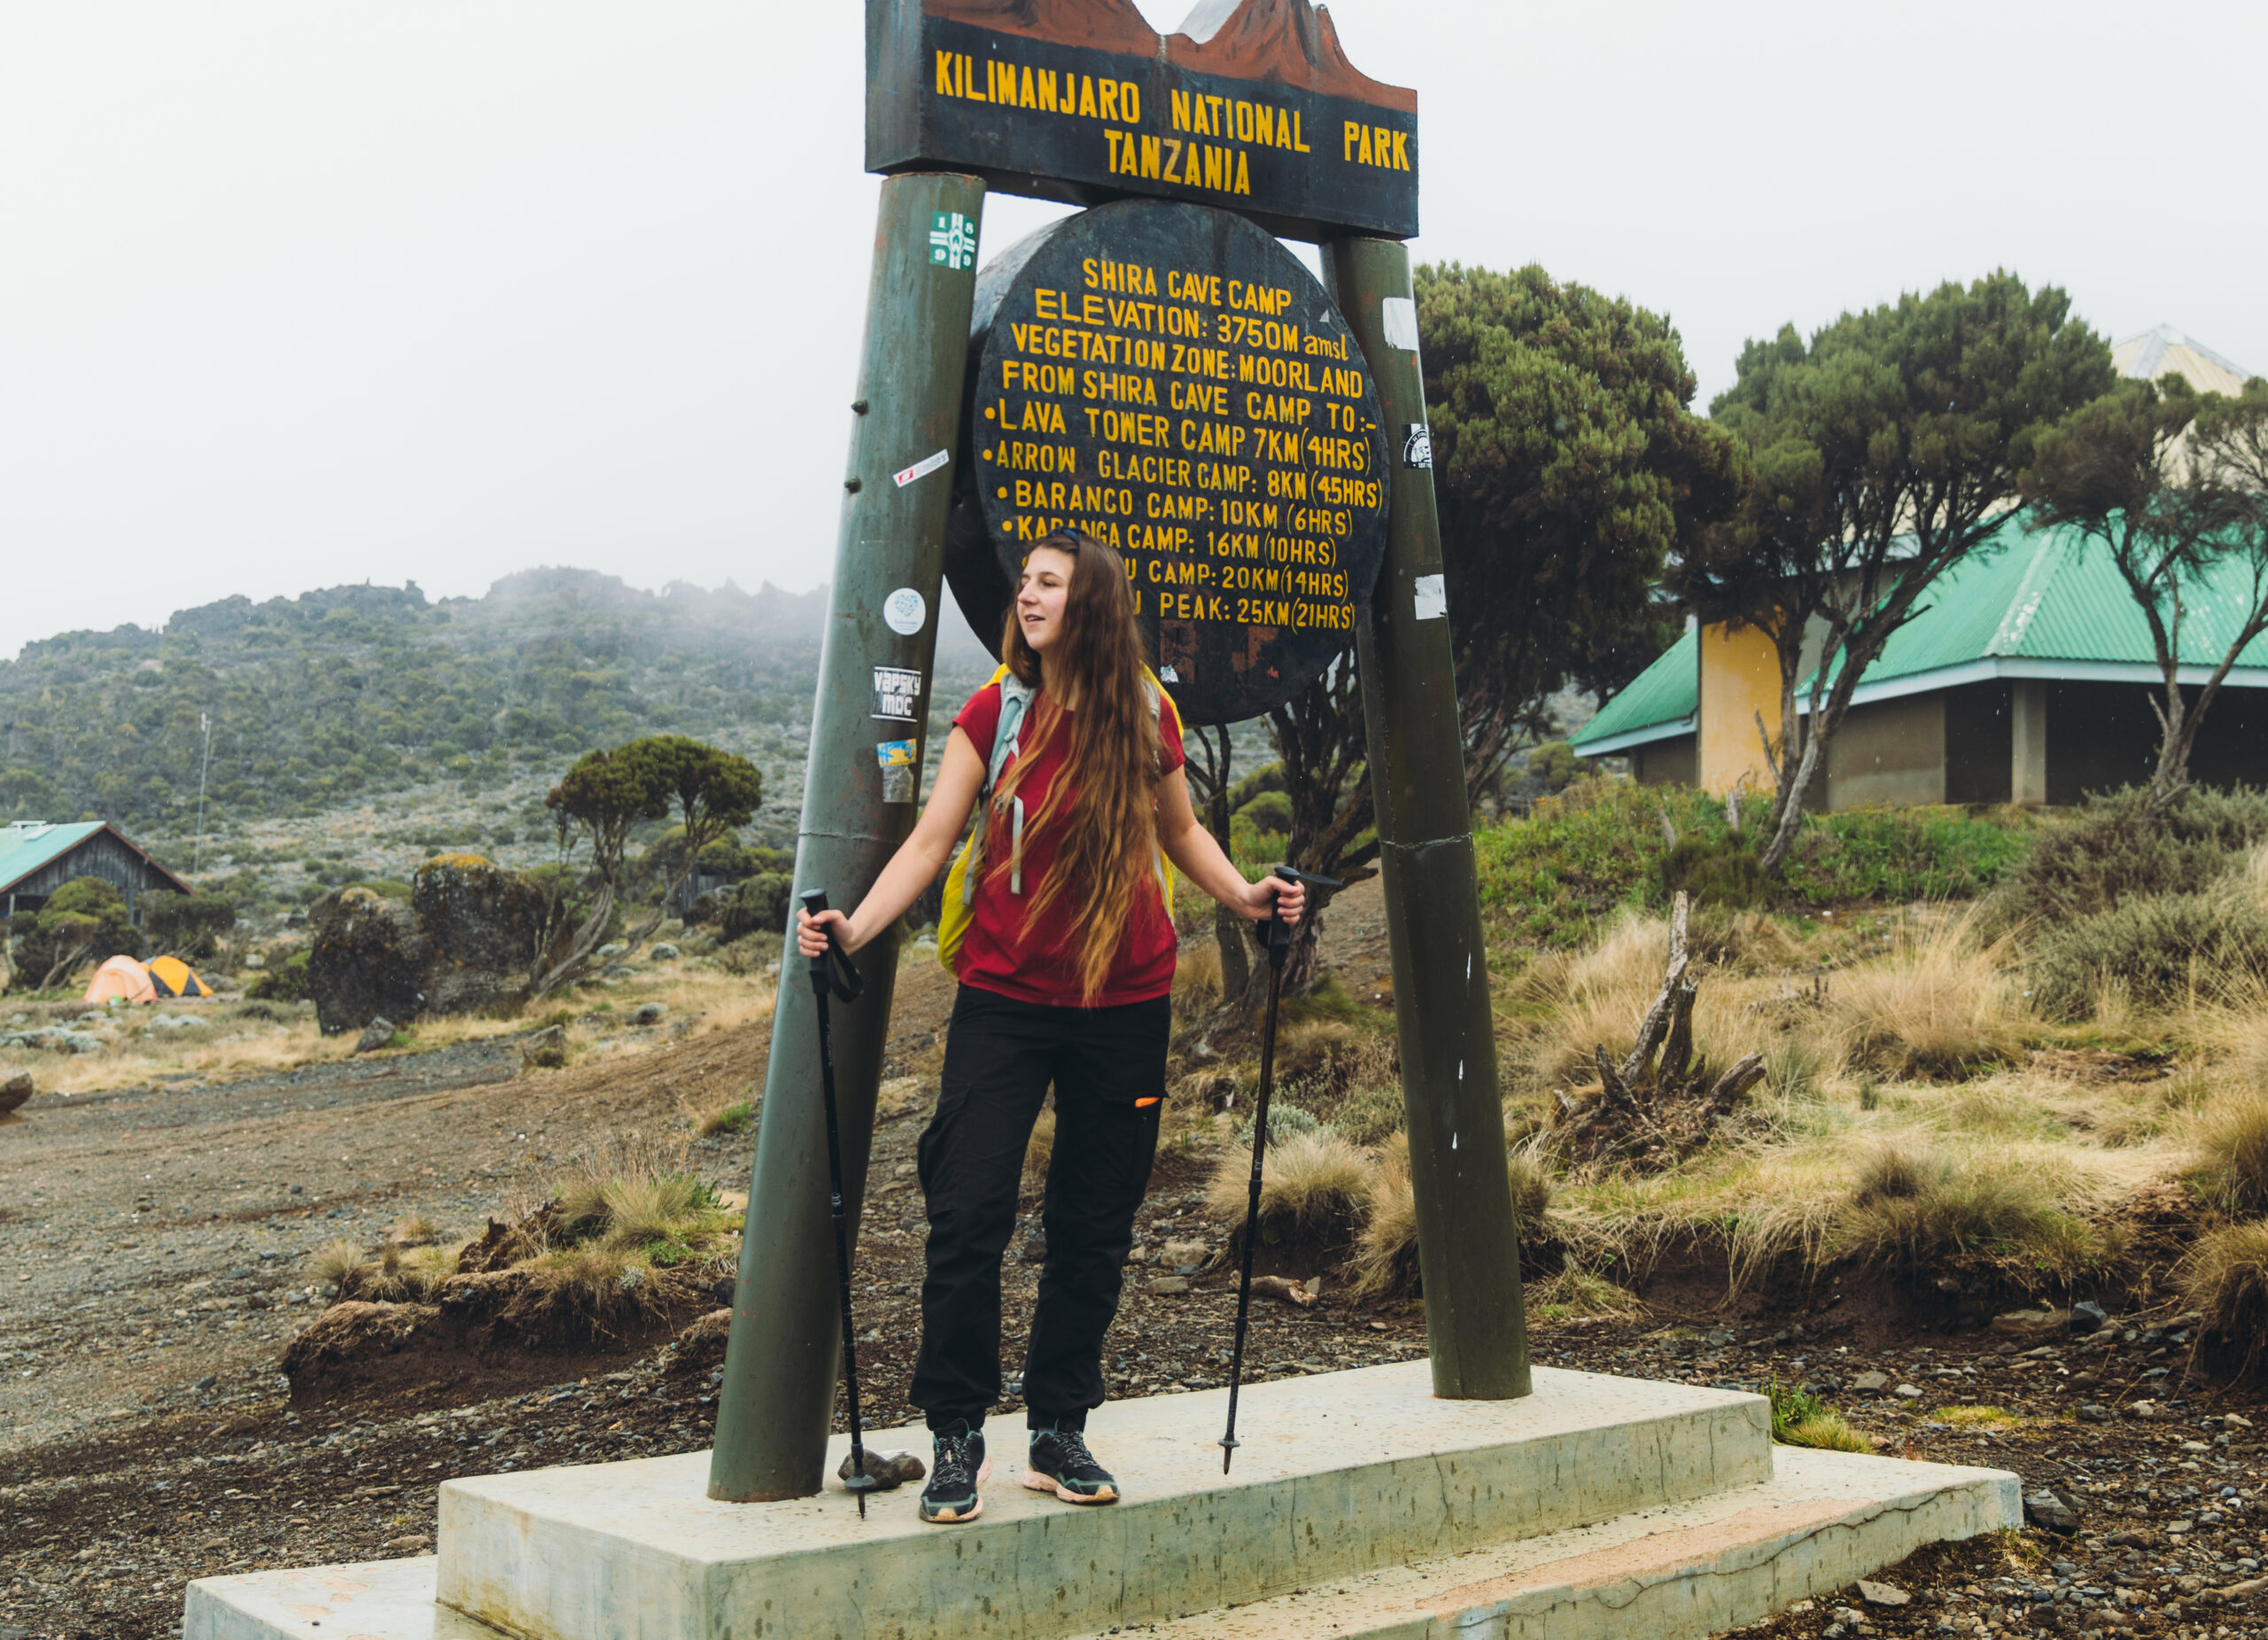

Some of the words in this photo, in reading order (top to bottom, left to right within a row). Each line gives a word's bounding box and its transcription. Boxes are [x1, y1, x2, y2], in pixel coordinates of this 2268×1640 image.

[936, 51, 1140, 123] KILIMANJARO
[1171, 89, 1310, 152] NATIONAL
[1344, 120, 1410, 171] PARK
[1104, 128, 1250, 195] TANZANIA
[1083, 259, 1157, 296] SHIRA
[1168, 271, 1222, 306] CAVE
[1228, 280, 1292, 315] CAMP
[1035, 288, 1208, 338] ELEVATION:
[1217, 314, 1298, 353] 3750M
[1303, 334, 1348, 361] amsl
[1011, 323, 1165, 371] VEGETATION
[1239, 354, 1363, 398] MOORLAND
[1003, 360, 1075, 395] FROM
[1083, 370, 1157, 406] SHIRA
[1170, 381, 1228, 416] CAVE
[1247, 392, 1310, 425] CAMP
[999, 398, 1066, 434] LAVA
[1181, 419, 1246, 456] CAMP
[997, 440, 1076, 473] ARROW
[1099, 450, 1191, 487] GLACIER
[1198, 462, 1256, 493] CAMP:
[1015, 479, 1132, 515] BARANCO
[1147, 493, 1214, 521] CAMP:
[1221, 500, 1278, 529] 10KM
[1128, 525, 1194, 553] CAMP:
[1149, 560, 1216, 586] CAMP:
[1161, 593, 1230, 620] PEAK:
